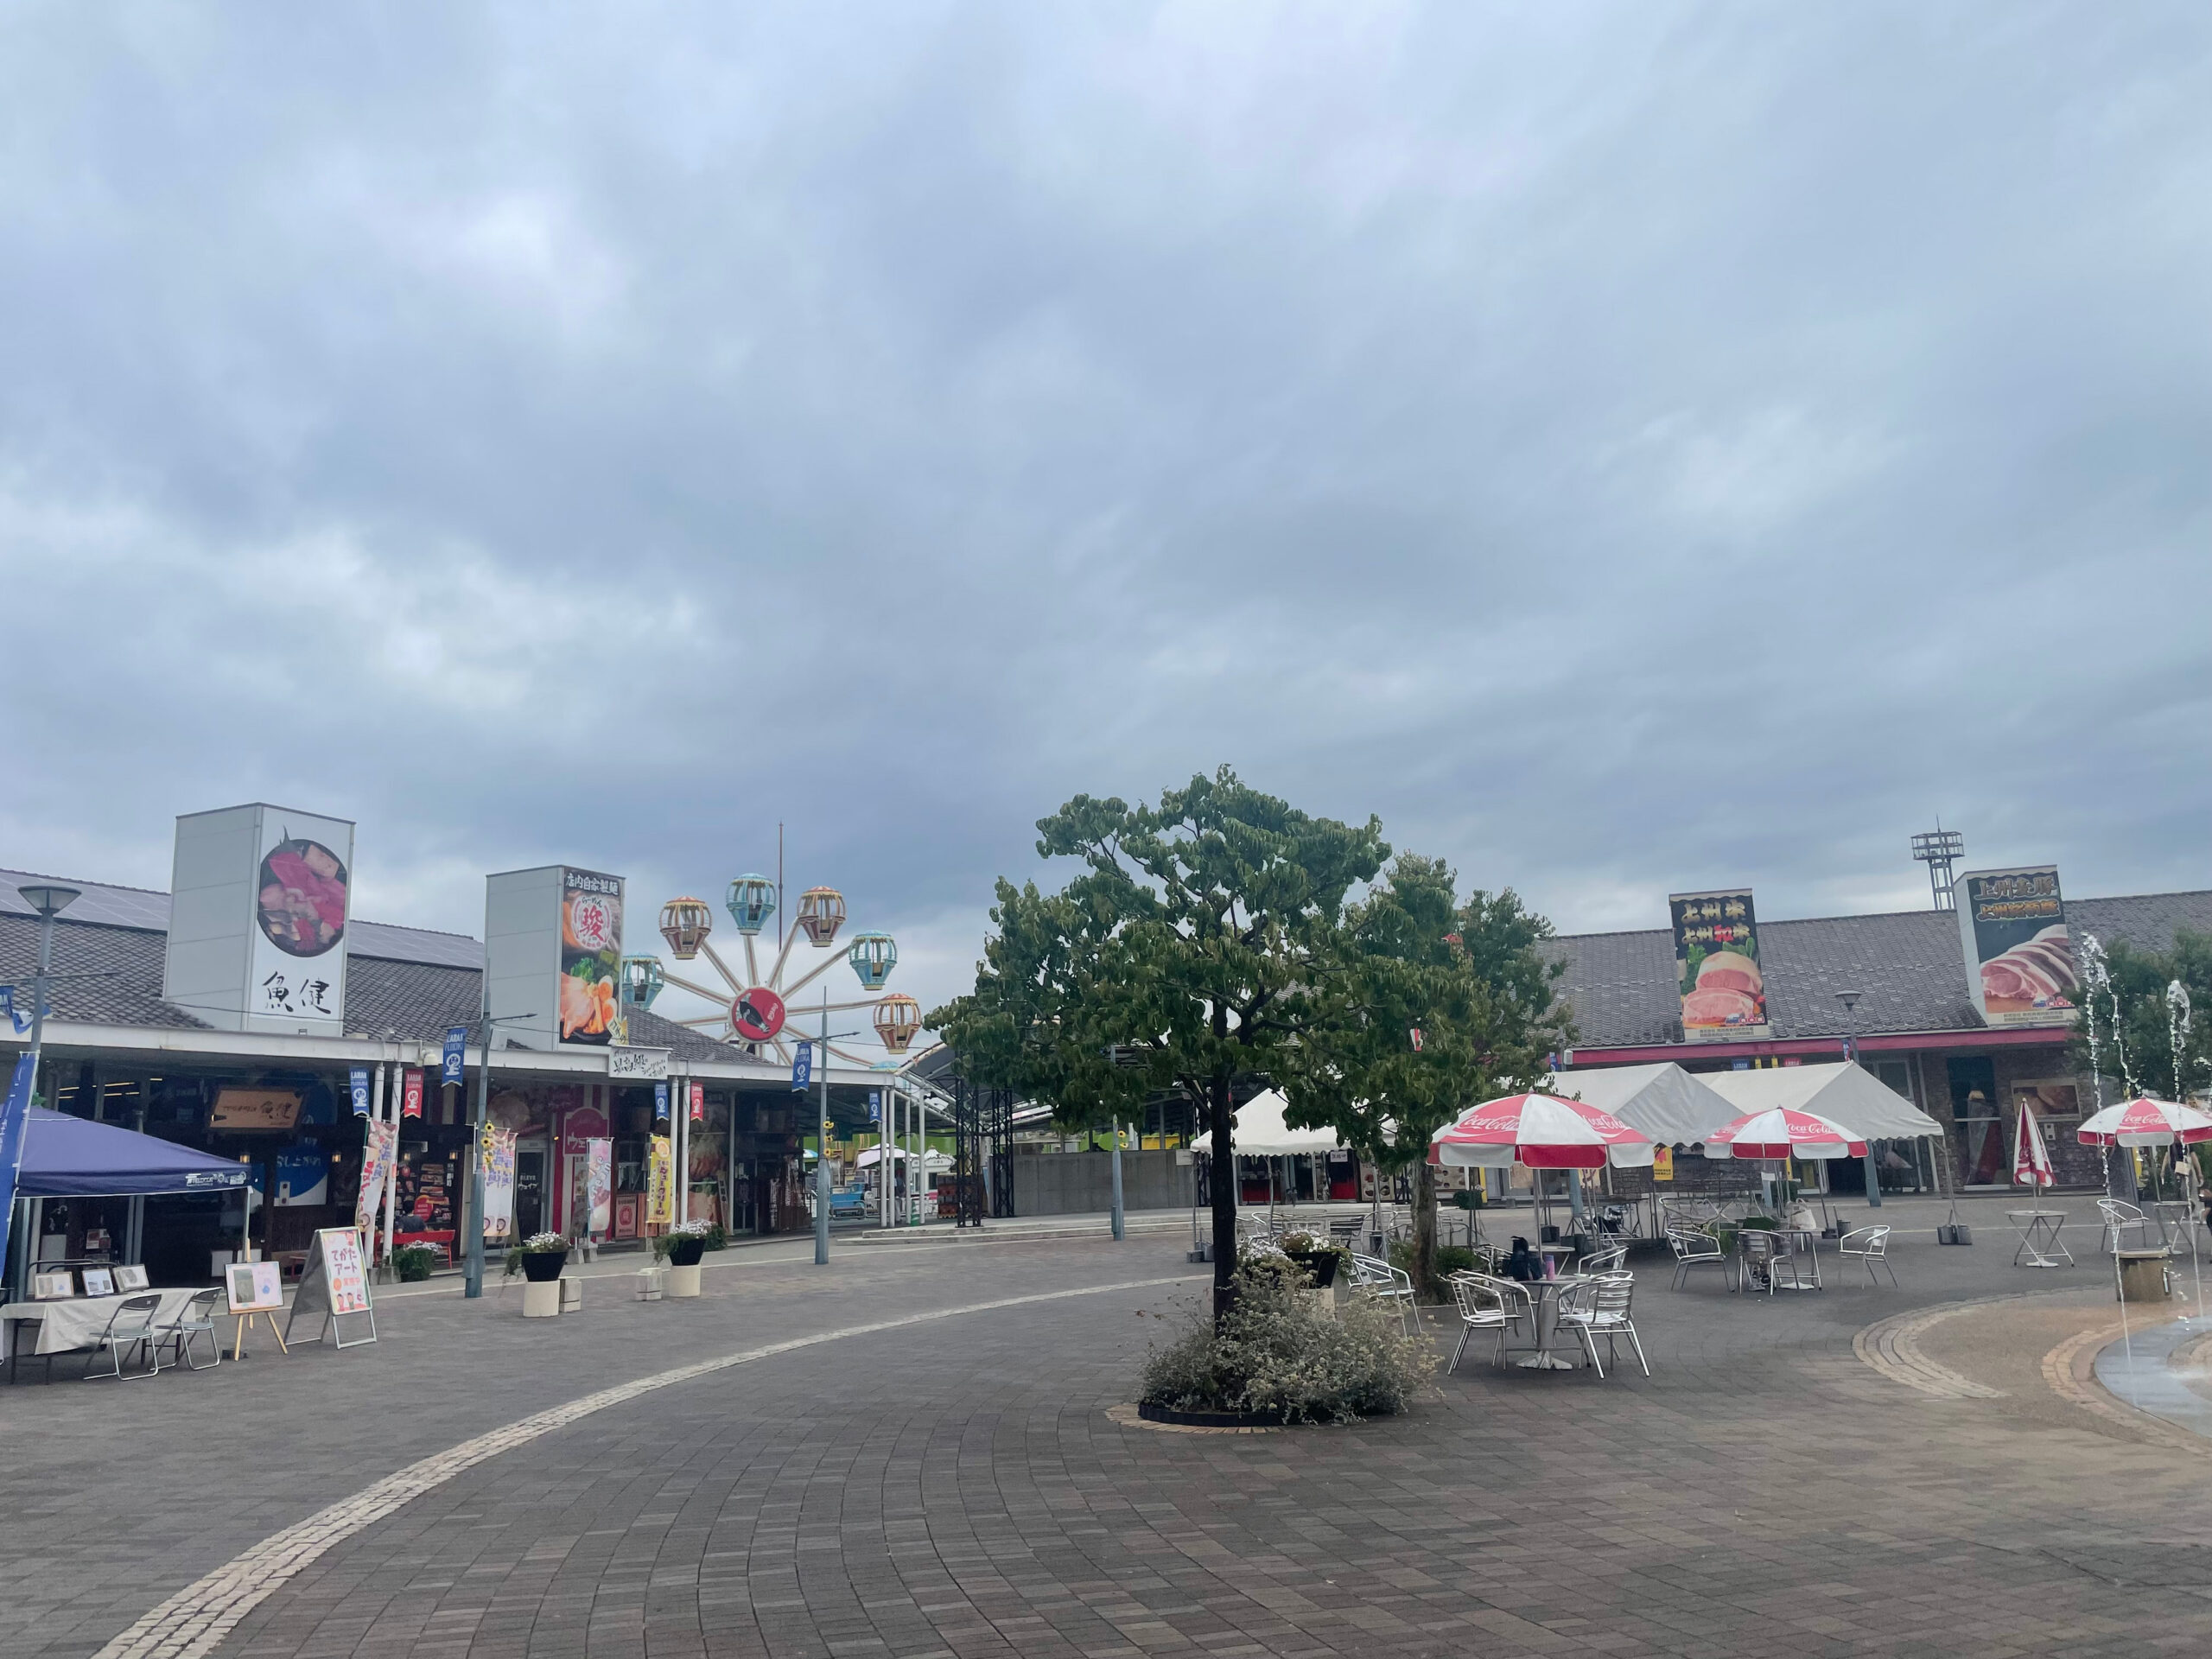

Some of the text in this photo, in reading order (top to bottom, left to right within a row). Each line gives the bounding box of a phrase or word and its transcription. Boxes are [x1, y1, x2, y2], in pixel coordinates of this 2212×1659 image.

[565, 873, 619, 895] 店内自家製麺
[263, 971, 331, 1014] 魚健
[331, 1248, 358, 1262] てがた
[334, 1262, 358, 1276] アート
